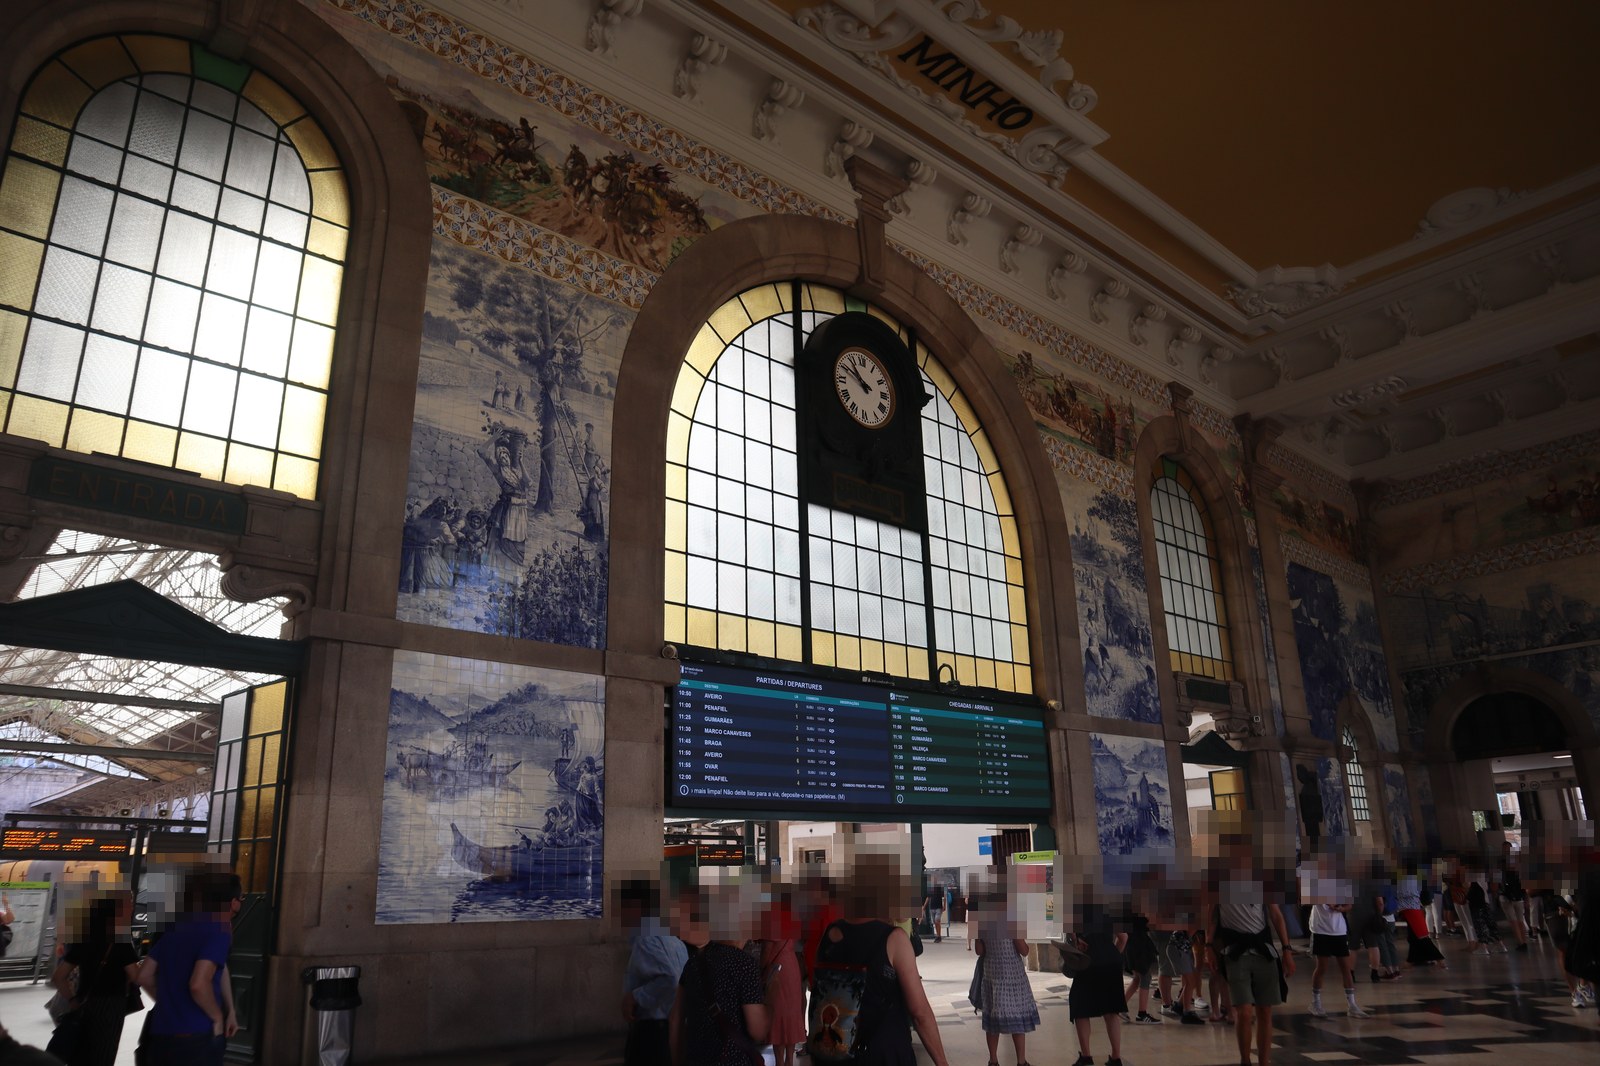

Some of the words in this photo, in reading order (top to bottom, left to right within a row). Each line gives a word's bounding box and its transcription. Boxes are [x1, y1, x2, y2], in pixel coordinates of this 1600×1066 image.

[897, 34, 1033, 130] MINHO
[46, 465, 227, 528] ENTRADA
[756, 676, 784, 686] PARTIDAS
[788, 680, 823, 691] DEPARTURES
[704, 704, 728, 712] PENAFIEL
[949, 701, 971, 709] CHEGADAS
[974, 704, 994, 712] ARRIVALS
[704, 715, 733, 724] GUIMARÃES
[723, 730, 751, 738] CANAVESES
